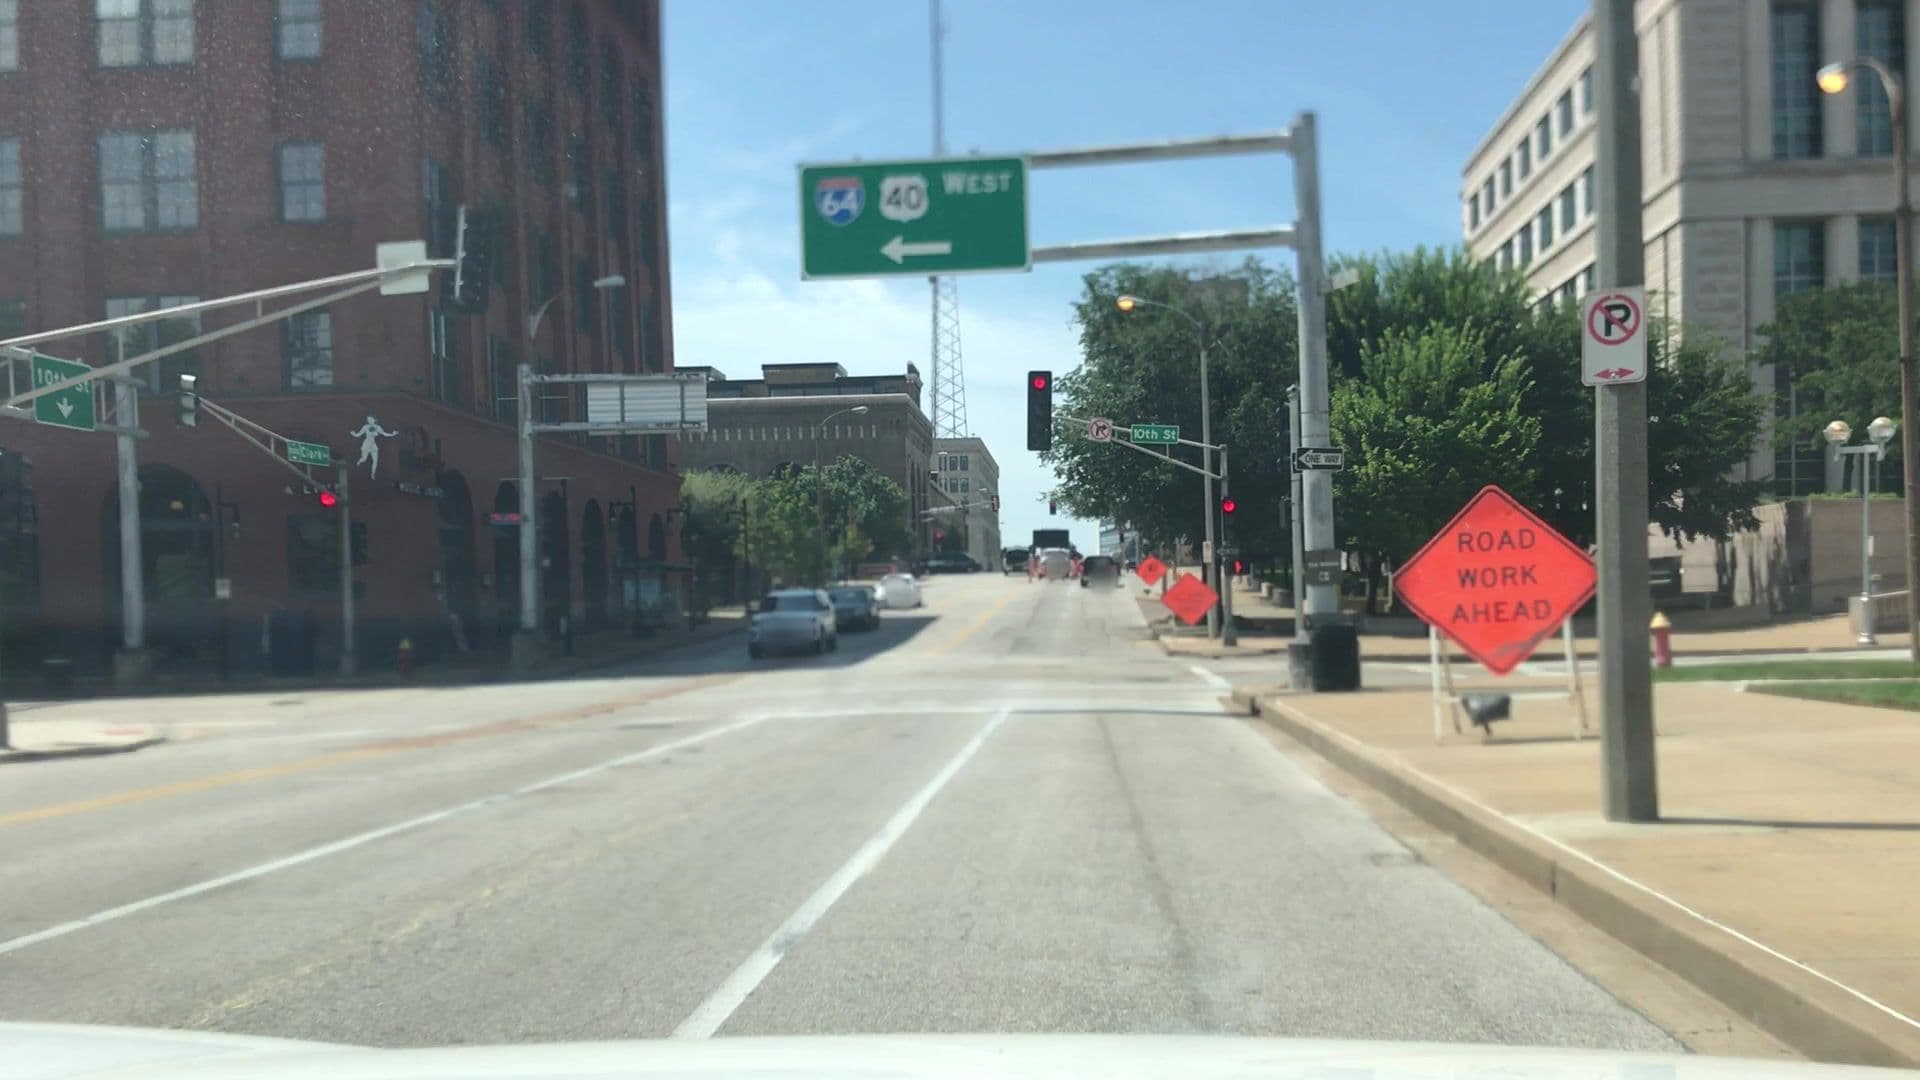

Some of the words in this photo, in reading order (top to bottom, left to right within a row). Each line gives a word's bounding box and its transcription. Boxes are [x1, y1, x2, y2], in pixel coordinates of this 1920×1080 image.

[942, 169, 1013, 195] WEST
[822, 190, 858, 216] 64
[885, 185, 921, 211] 40
[1134, 429, 1158, 440] 10th
[1163, 429, 1176, 440] St
[1305, 454, 1321, 463] ONE
[1324, 454, 1339, 463] WAY
[1457, 528, 1536, 553] ROAD
[1457, 564, 1538, 589] WORK
[1451, 599, 1552, 625] AHEAD
